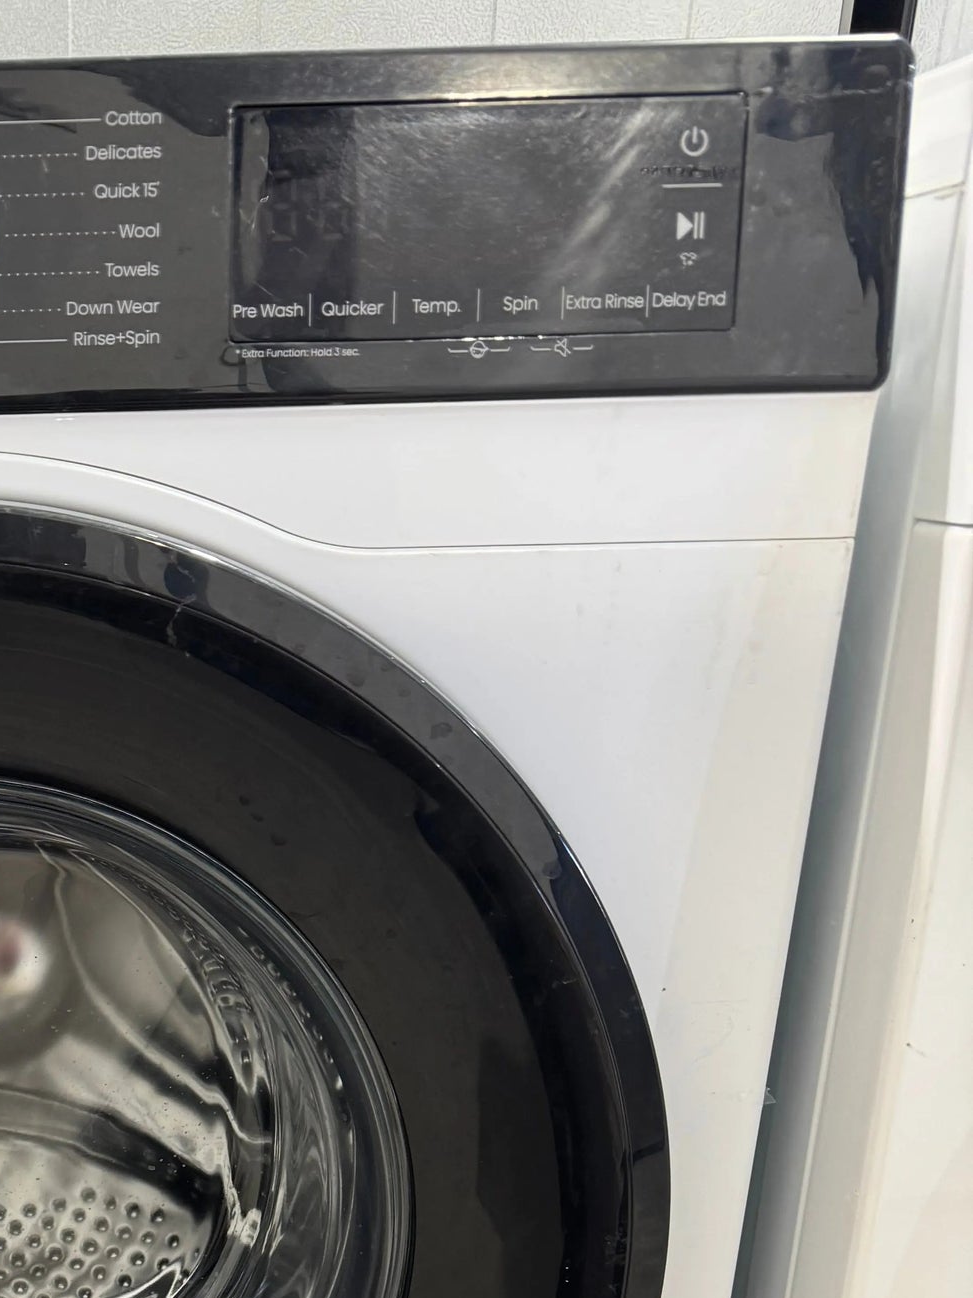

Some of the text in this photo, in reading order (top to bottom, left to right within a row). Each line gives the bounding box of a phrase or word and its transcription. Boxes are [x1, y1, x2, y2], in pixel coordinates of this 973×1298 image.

[105, 110, 162, 127] Cotton
[85, 144, 162, 161] Delicates
[94, 182, 141, 199] Quick
[118, 222, 160, 239] Wool
[104, 261, 160, 278] Towels
[66, 299, 161, 316] Down Wear
[321, 300, 385, 317] Quicker
[411, 298, 461, 317] Temp.
[503, 295, 539, 315] Spin
[565, 293, 645, 310] Extra Rinse
[651, 290, 727, 311] Delay End
[232, 302, 304, 319] Pre Wash
[73, 329, 160, 349] Rinse+Spin
[242, 349, 264, 358] Extra
[266, 349, 309, 357] Function:
[311, 348, 332, 356] Hold
[334, 348, 340, 356] 3
